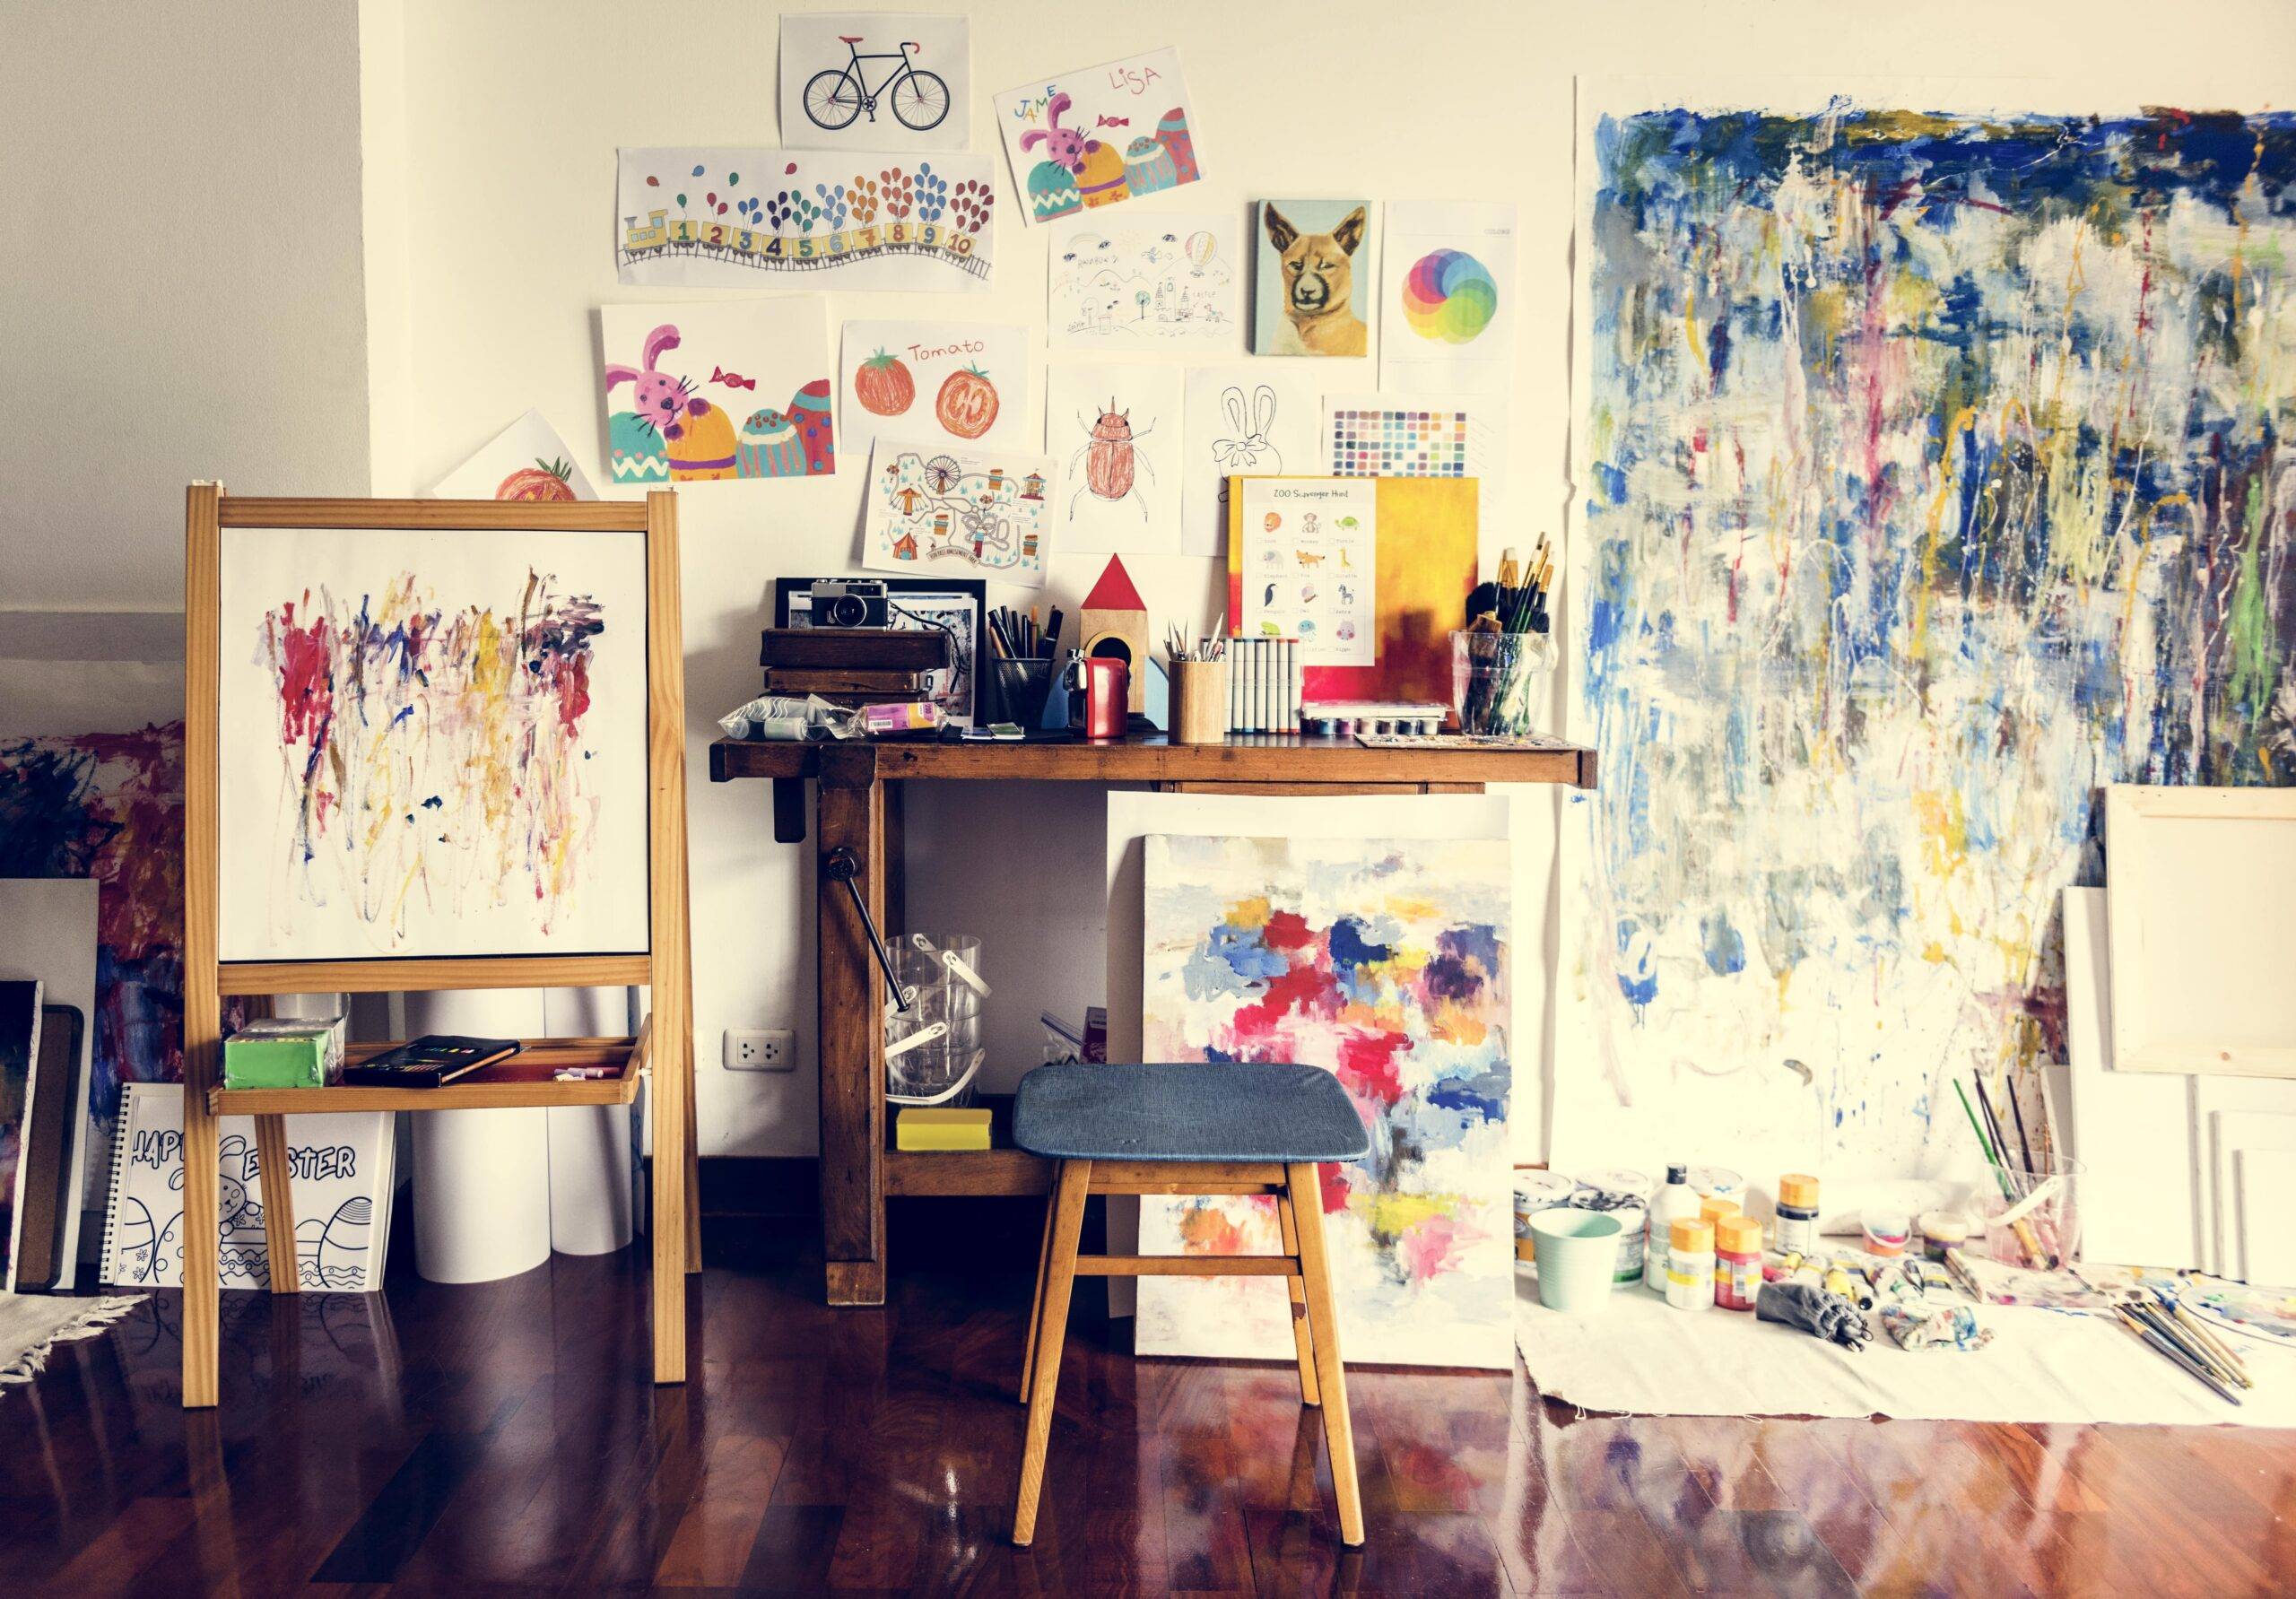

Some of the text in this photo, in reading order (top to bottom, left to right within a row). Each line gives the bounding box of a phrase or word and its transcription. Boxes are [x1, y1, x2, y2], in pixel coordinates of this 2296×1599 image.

[678, 222, 971, 256] 1 2 3 4 5 6 7 8 9 10
[908, 340, 985, 362] Tomato
[1274, 489, 1349, 500] ZOO Scavenger Hunt
[132, 1130, 185, 1169] HAP
[241, 1146, 355, 1181] ESTER
